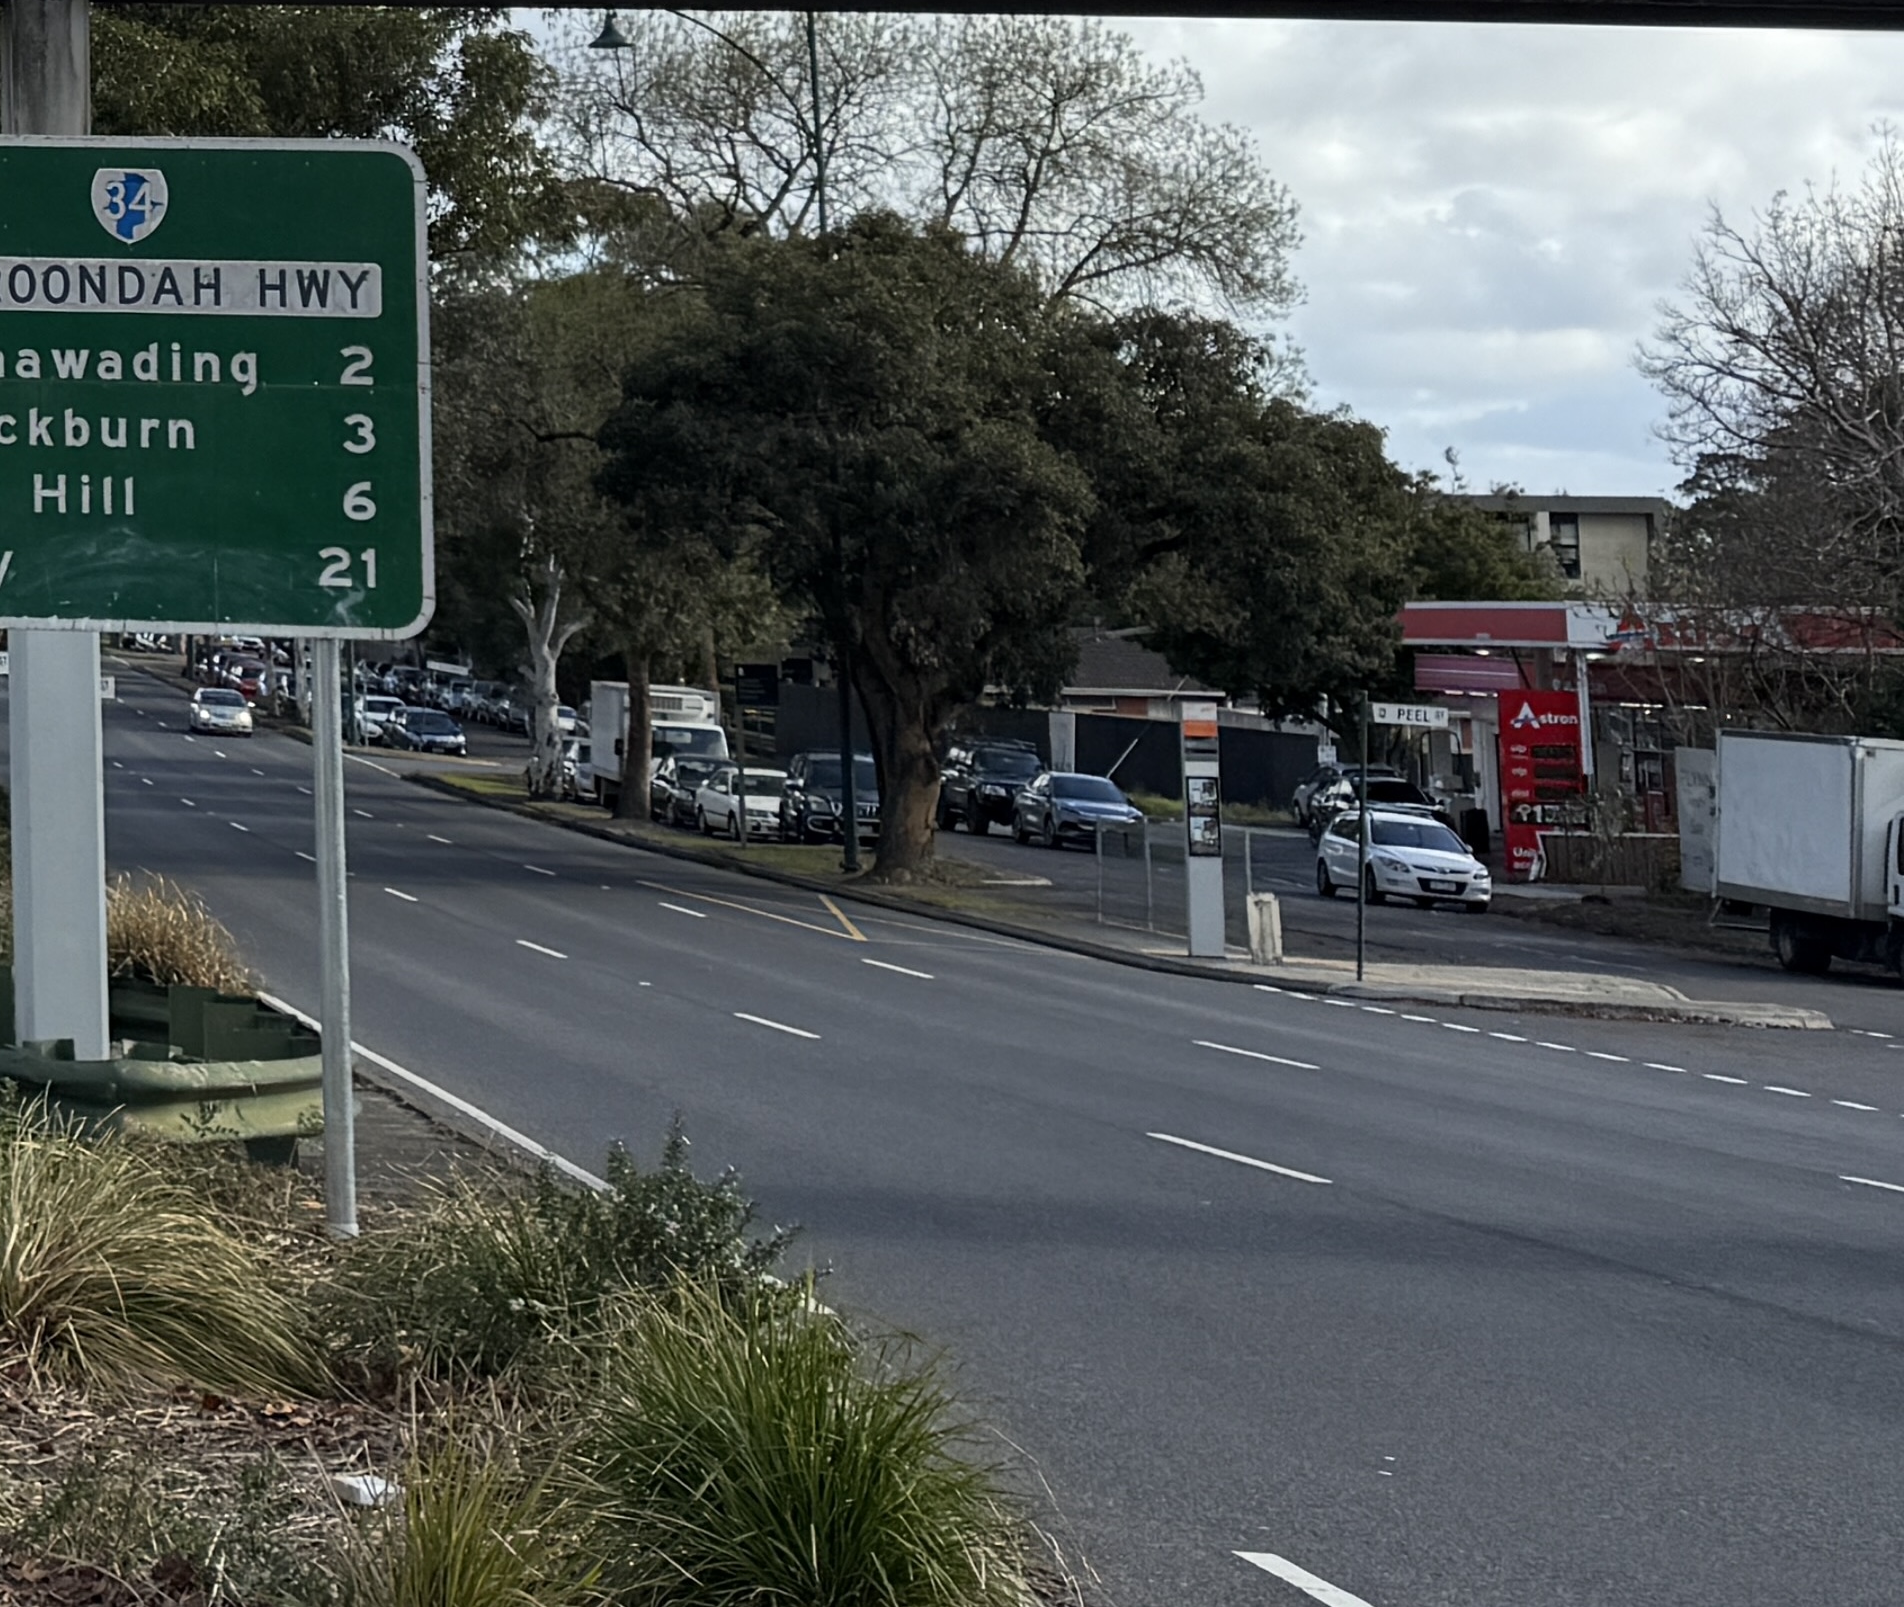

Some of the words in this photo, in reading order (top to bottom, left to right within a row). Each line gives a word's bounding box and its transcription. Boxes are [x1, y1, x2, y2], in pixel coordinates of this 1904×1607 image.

[103, 180, 153, 224] 34
[258, 268, 369, 309] HWY
[339, 344, 375, 386] 2
[342, 413, 377, 454] 3
[33, 474, 135, 515] Hill
[342, 481, 377, 521] 6
[318, 546, 378, 588] 21
[1396, 707, 1431, 723] PEEL
[1510, 701, 1579, 730] Astron
